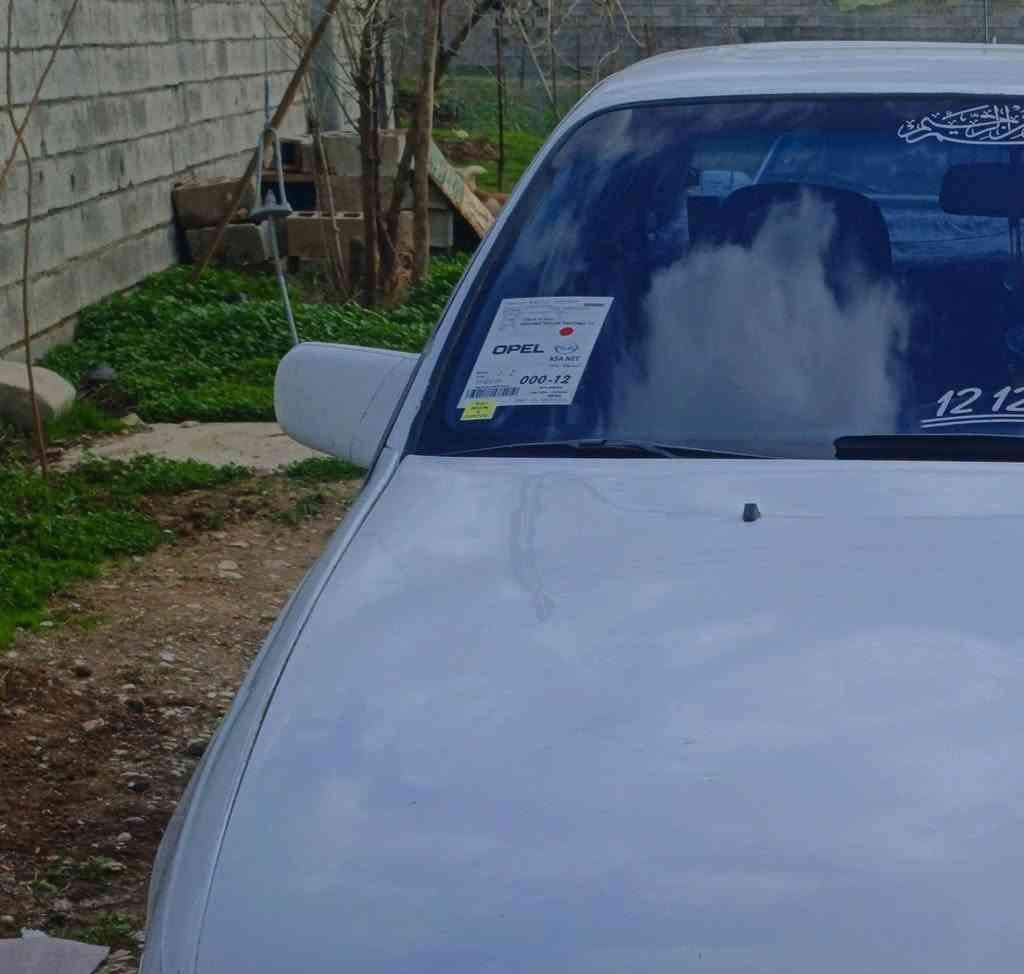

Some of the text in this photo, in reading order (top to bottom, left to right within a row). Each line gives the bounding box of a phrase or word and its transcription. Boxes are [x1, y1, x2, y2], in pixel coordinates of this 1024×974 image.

[492, 343, 545, 355] OPEL
[519, 374, 571, 385] 000-12
[936, 387, 982, 417] 12
